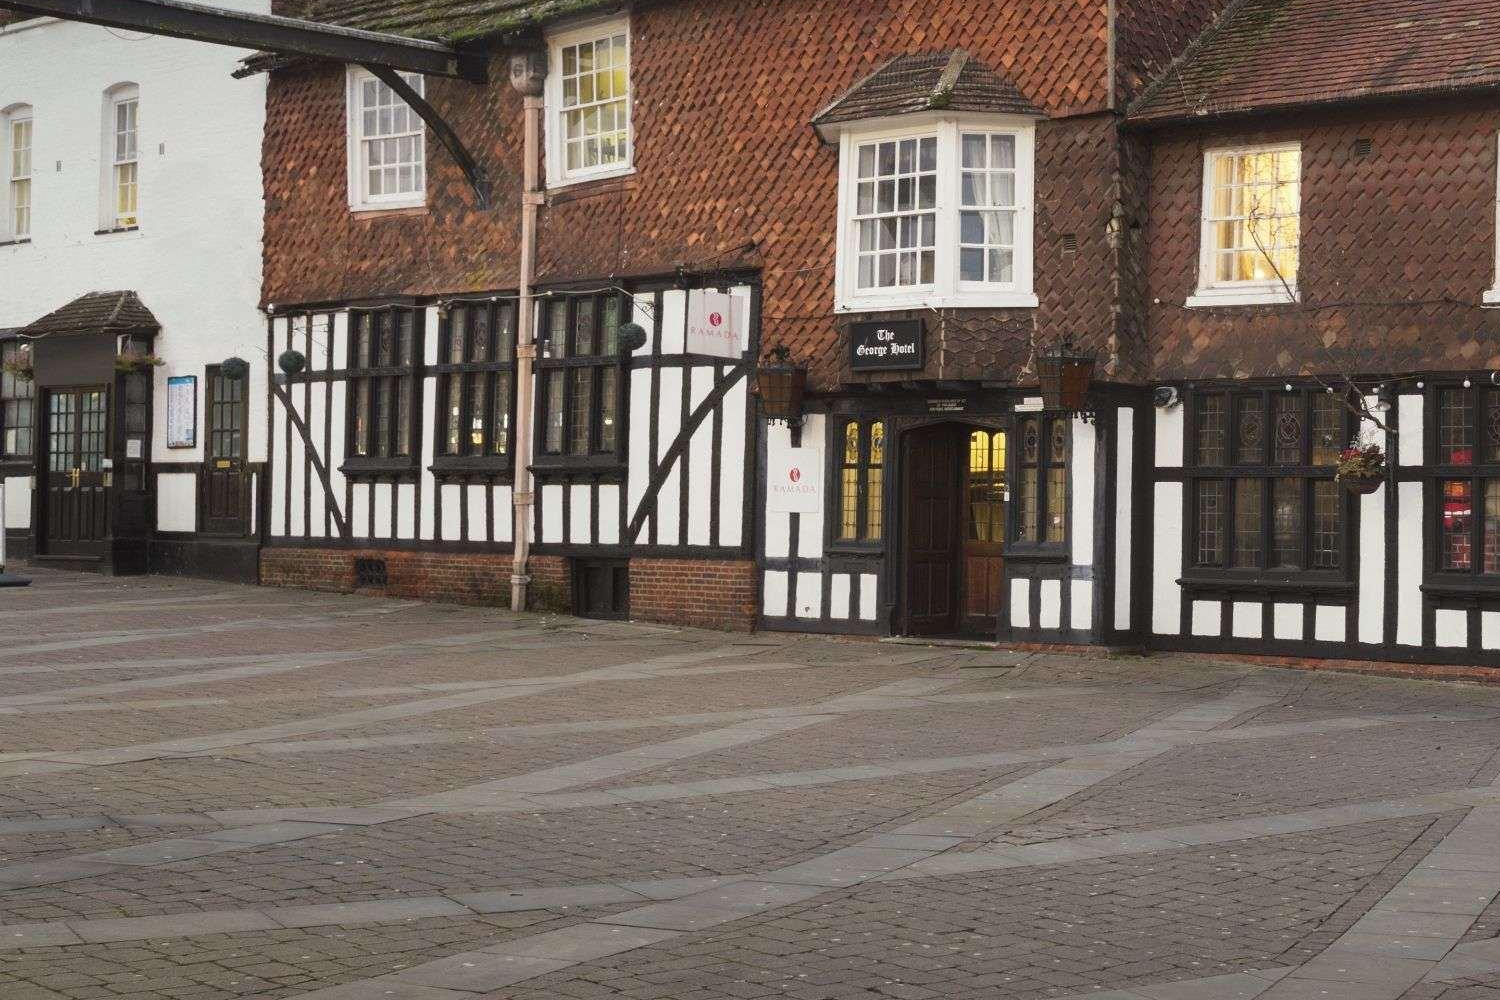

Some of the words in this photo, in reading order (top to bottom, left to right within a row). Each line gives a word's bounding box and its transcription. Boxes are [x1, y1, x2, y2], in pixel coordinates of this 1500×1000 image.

[690, 326, 738, 340] RAMADA
[877, 329, 895, 342] The
[857, 344, 888, 357] George
[890, 343, 915, 356] Hotel
[772, 485, 817, 494] RAMADA
